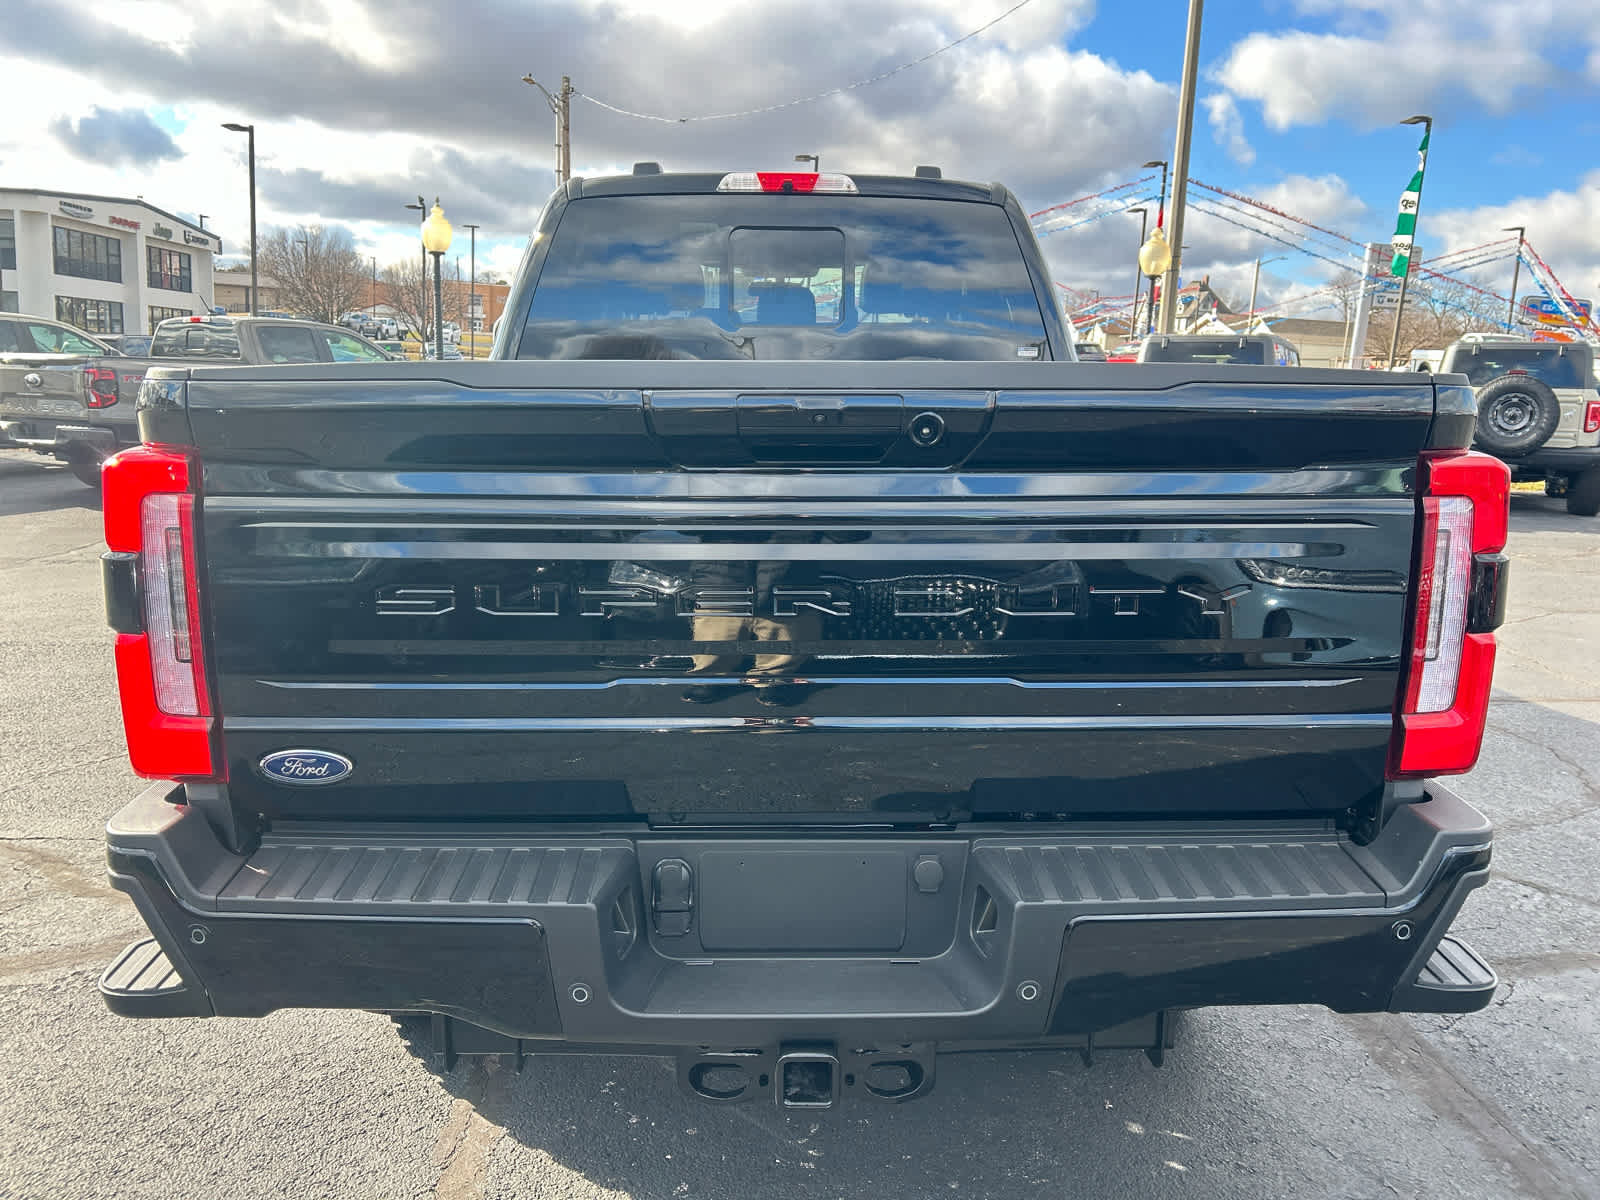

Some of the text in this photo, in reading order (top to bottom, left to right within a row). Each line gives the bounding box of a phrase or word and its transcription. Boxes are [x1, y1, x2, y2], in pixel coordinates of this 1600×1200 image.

[375, 582, 1254, 617] SUPER DUTY
[280, 757, 330, 777] Ford
